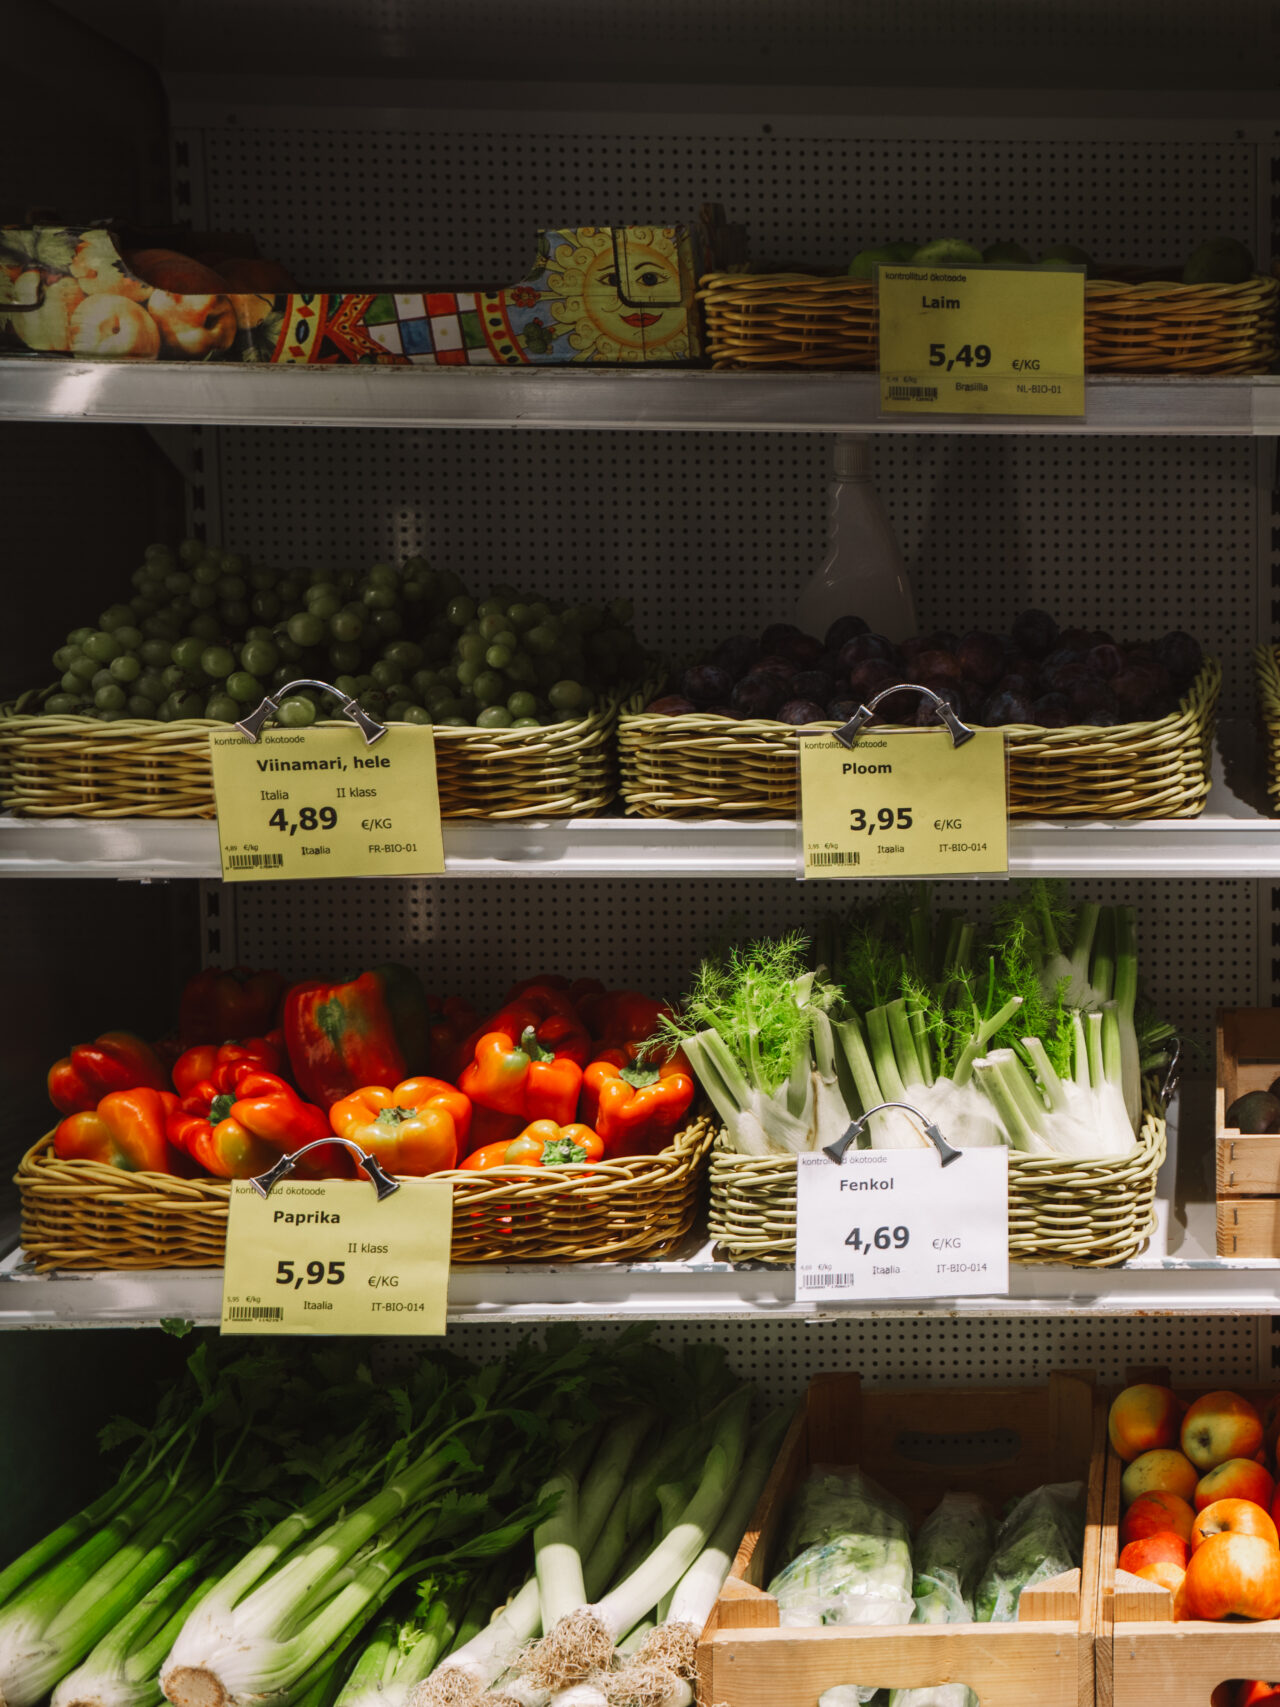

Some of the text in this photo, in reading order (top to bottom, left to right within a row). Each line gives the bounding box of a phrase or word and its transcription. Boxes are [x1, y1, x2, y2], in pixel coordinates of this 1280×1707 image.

[885, 272, 967, 282] kontrollitud ökotoode
[922, 296, 961, 309] Laim
[929, 343, 1040, 372] 5,49 €/KG
[1016, 384, 1061, 394] NL-BIO-01
[266, 735, 305, 744] ökotoode
[256, 756, 391, 772] Viinamari, hele
[842, 763, 892, 774] Ploom
[260, 787, 377, 801] Italia II klass
[268, 806, 392, 836] 4,89 €/KG
[850, 807, 962, 836] 3,95 €/KG
[301, 843, 417, 855] Itaalia FR-BIO-01
[877, 843, 987, 854] Itaalia IT-BIO-014
[850, 1155, 887, 1164] ökotoode
[840, 1178, 894, 1191] Fenkol
[286, 1186, 326, 1196] ökotoode
[274, 1210, 340, 1226] Paprika
[845, 1225, 961, 1255] 4,69 €/KG
[348, 1243, 388, 1254] II klass
[873, 1263, 987, 1275] Itaalia IT-BIO-014
[276, 1261, 399, 1290] 5,95 €/KG
[303, 1301, 424, 1312] Itaalia IT-BIO-014
